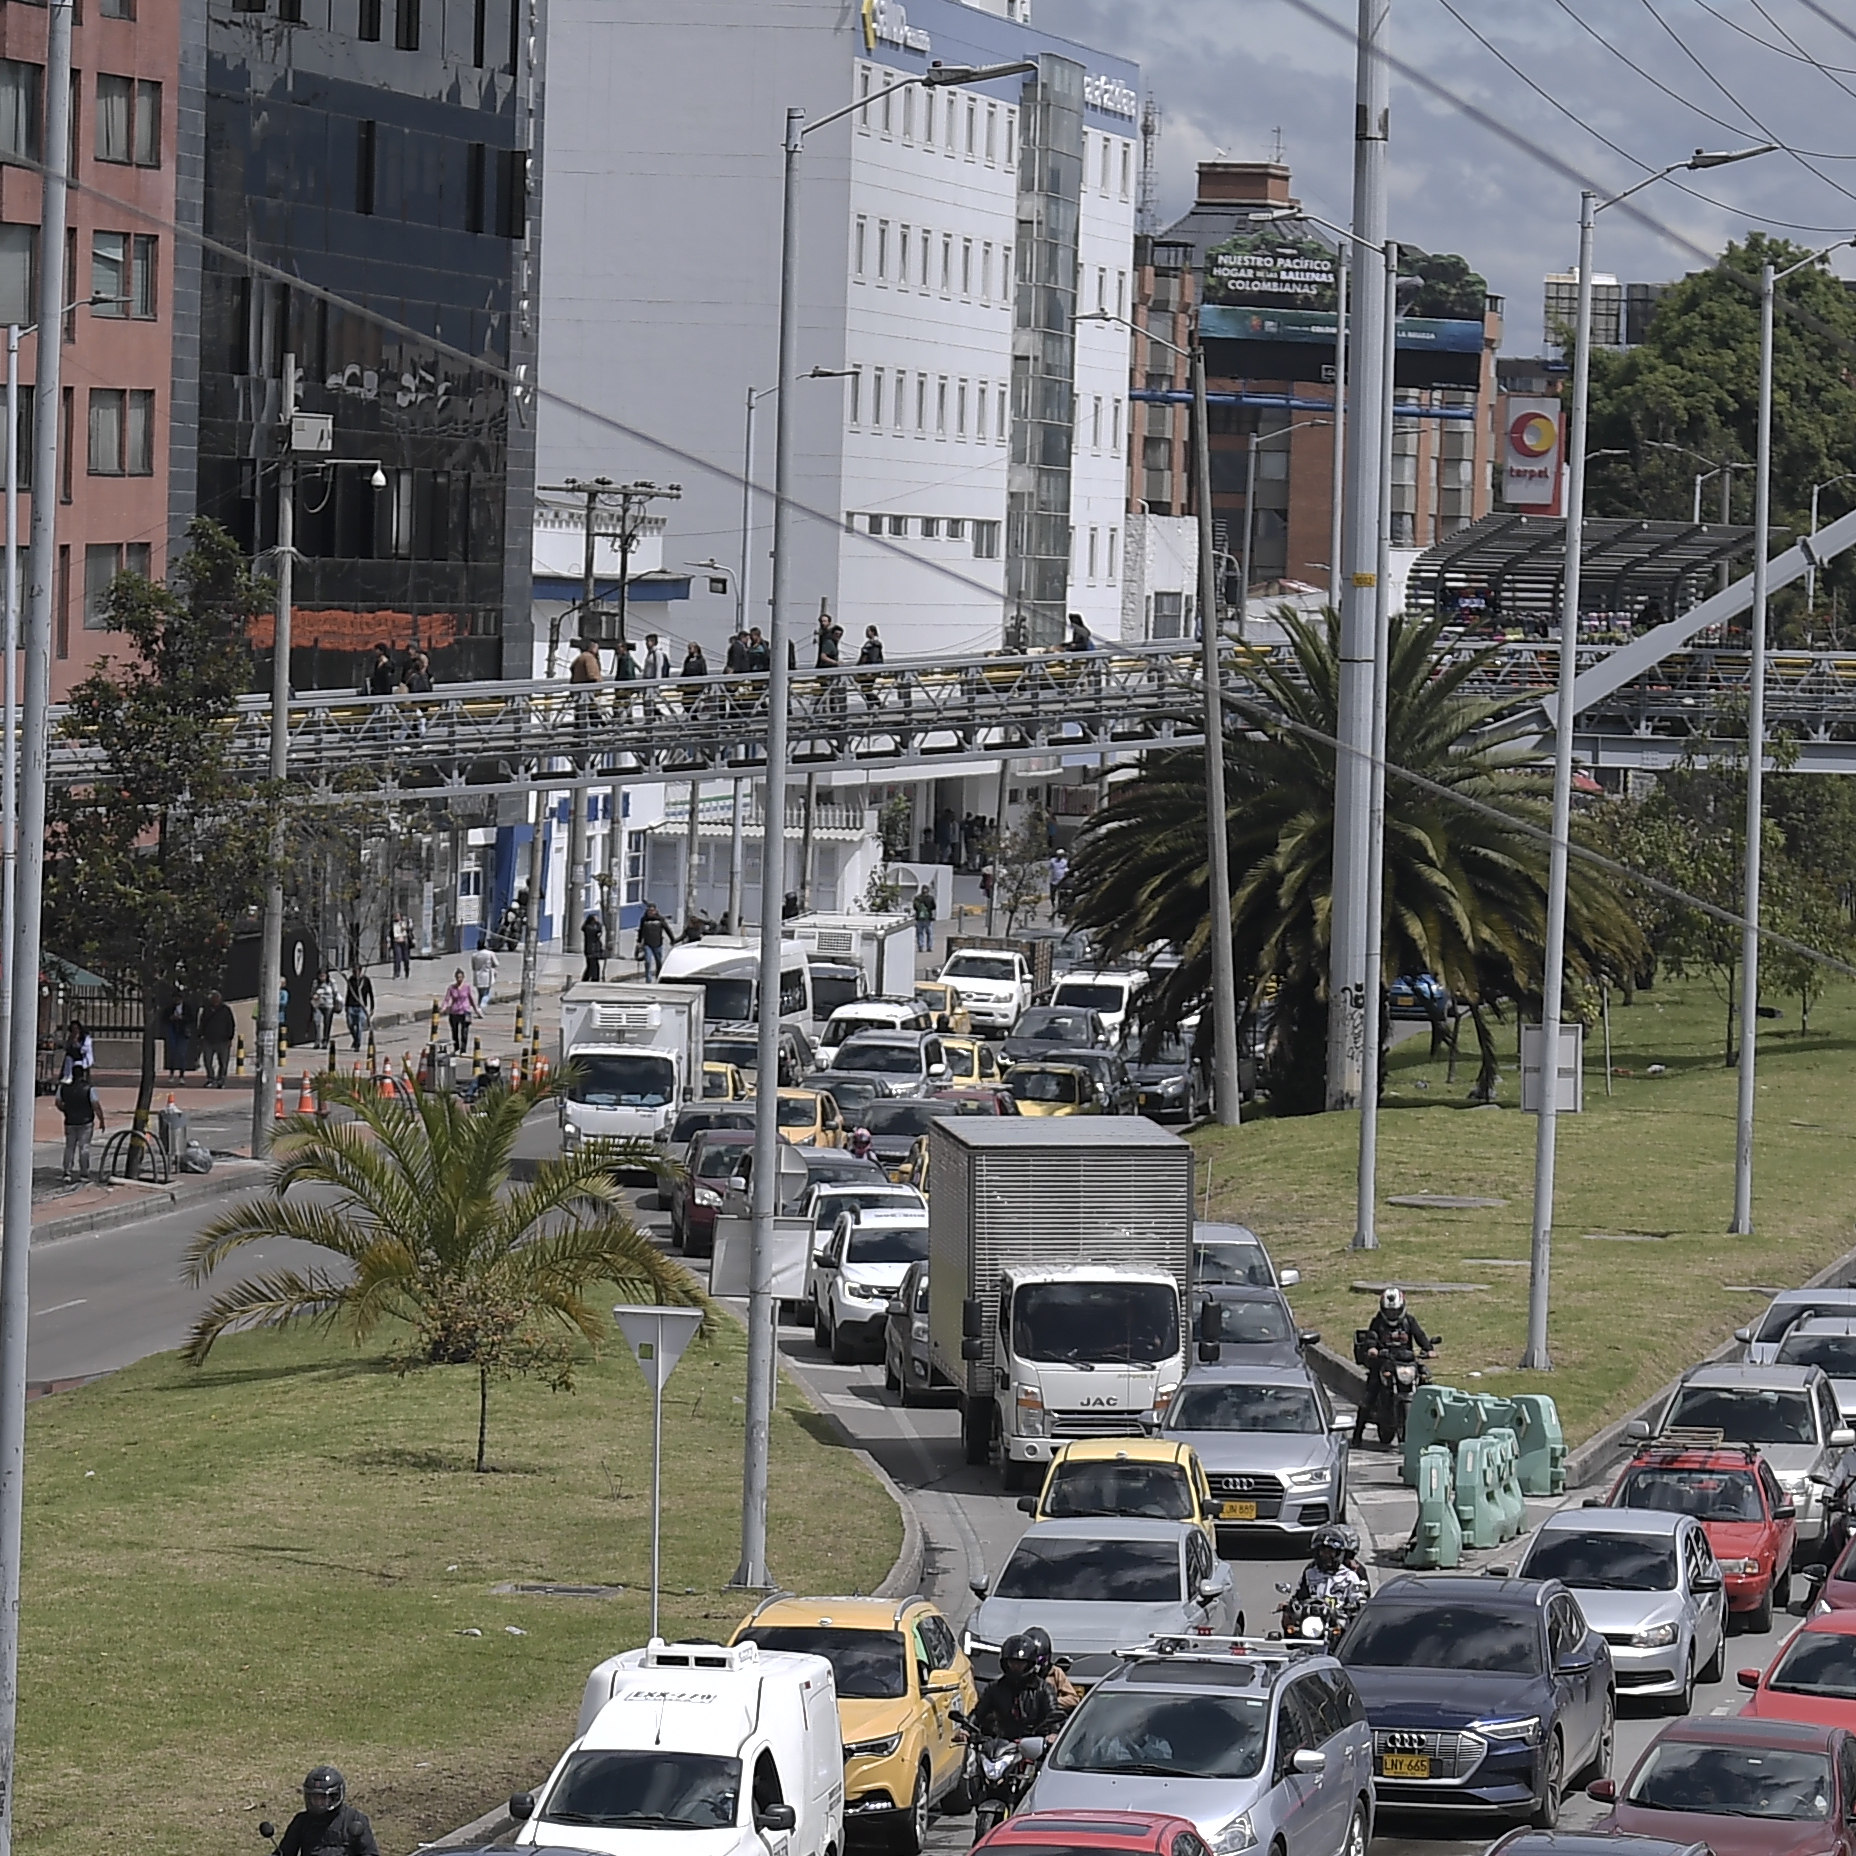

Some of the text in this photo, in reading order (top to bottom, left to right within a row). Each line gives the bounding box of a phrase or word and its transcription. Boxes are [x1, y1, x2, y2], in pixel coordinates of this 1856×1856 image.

[1217, 254, 1332, 270] NUESTRO PACÍFICO
[1212, 267, 1254, 277] HOGAR
[1280, 272, 1335, 282] BALLENAS
[1227, 279, 1318, 294] COLOMBIANAS
[1510, 465, 1550, 480] terpel
[1079, 1396, 1119, 1407] JAC
[1384, 1758, 1427, 1772] LNY 665
